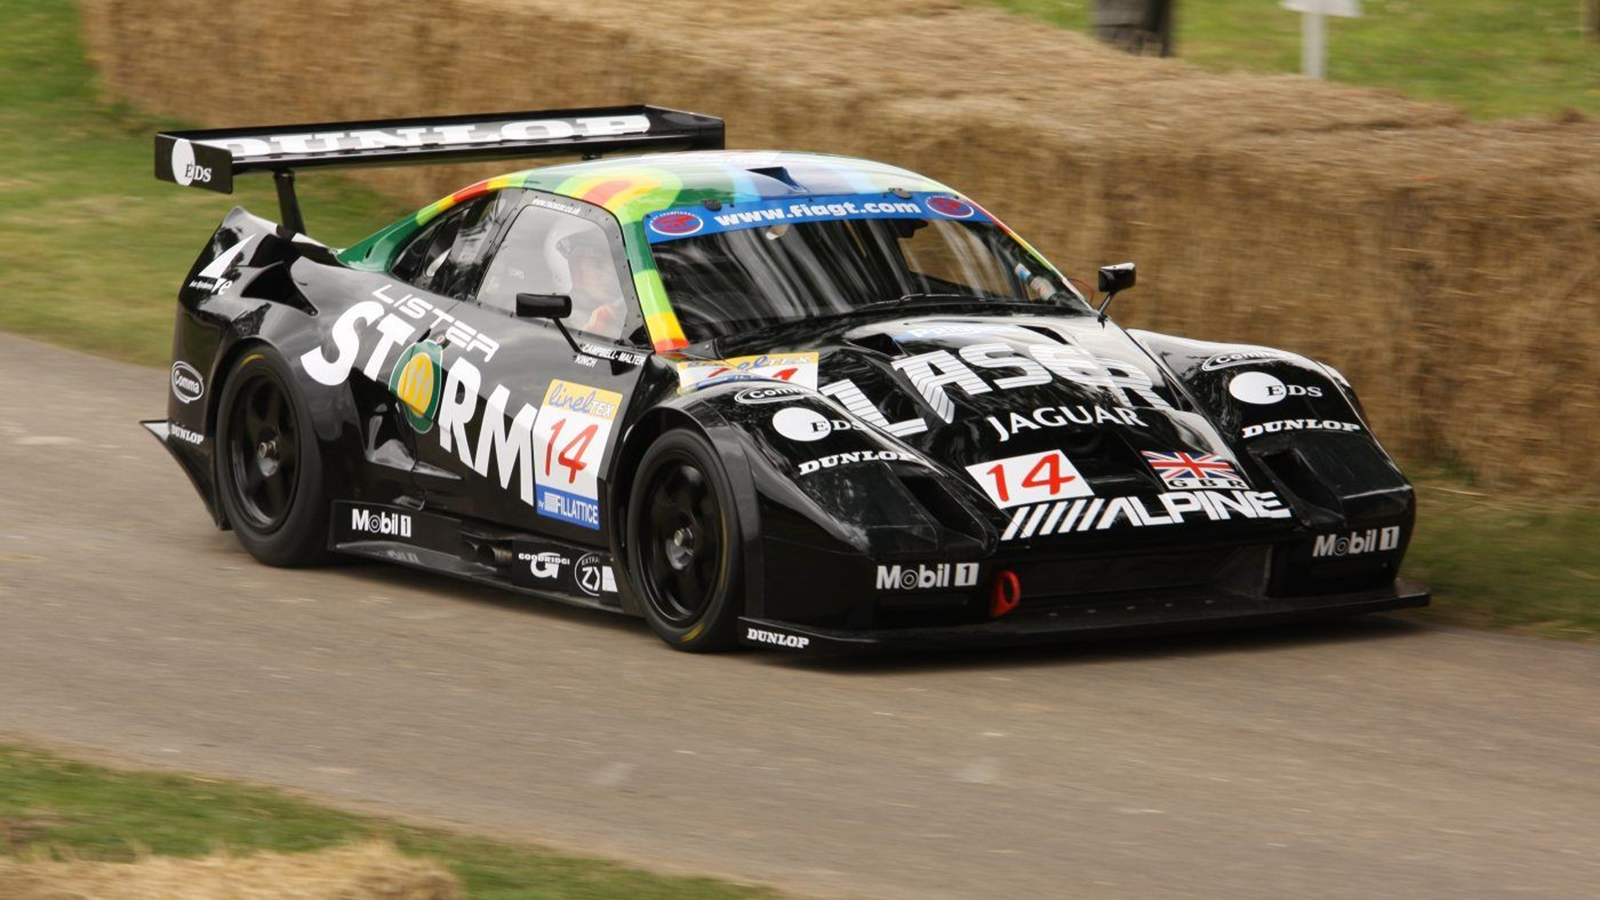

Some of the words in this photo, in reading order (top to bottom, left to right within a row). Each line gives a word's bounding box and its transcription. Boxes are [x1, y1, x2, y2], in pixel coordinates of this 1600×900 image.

[194, 115, 650, 157] DUNLOP
[184, 164, 212, 182] EDS
[714, 202, 921, 226] www.fiagt.com
[371, 284, 500, 362] LISTER
[175, 369, 200, 394] Comma
[818, 343, 1174, 438] LASER
[1266, 384, 1323, 397] EDS
[171, 424, 204, 445] DUNLOP
[987, 406, 1149, 442] JAGUAR
[1242, 418, 1361, 439] DUNLOP
[545, 418, 599, 484] 14
[986, 453, 1077, 502] 14
[352, 508, 398, 535] Mobil
[400, 514, 411, 538] 1
[556, 496, 599, 525] FILLATTICE
[1096, 491, 1292, 530] ALPINE
[1312, 529, 1378, 558] Mobil
[1379, 525, 1400, 551] 1
[876, 563, 950, 590] Mobil
[954, 562, 980, 587] 1
[746, 627, 810, 649] DUNLOP
